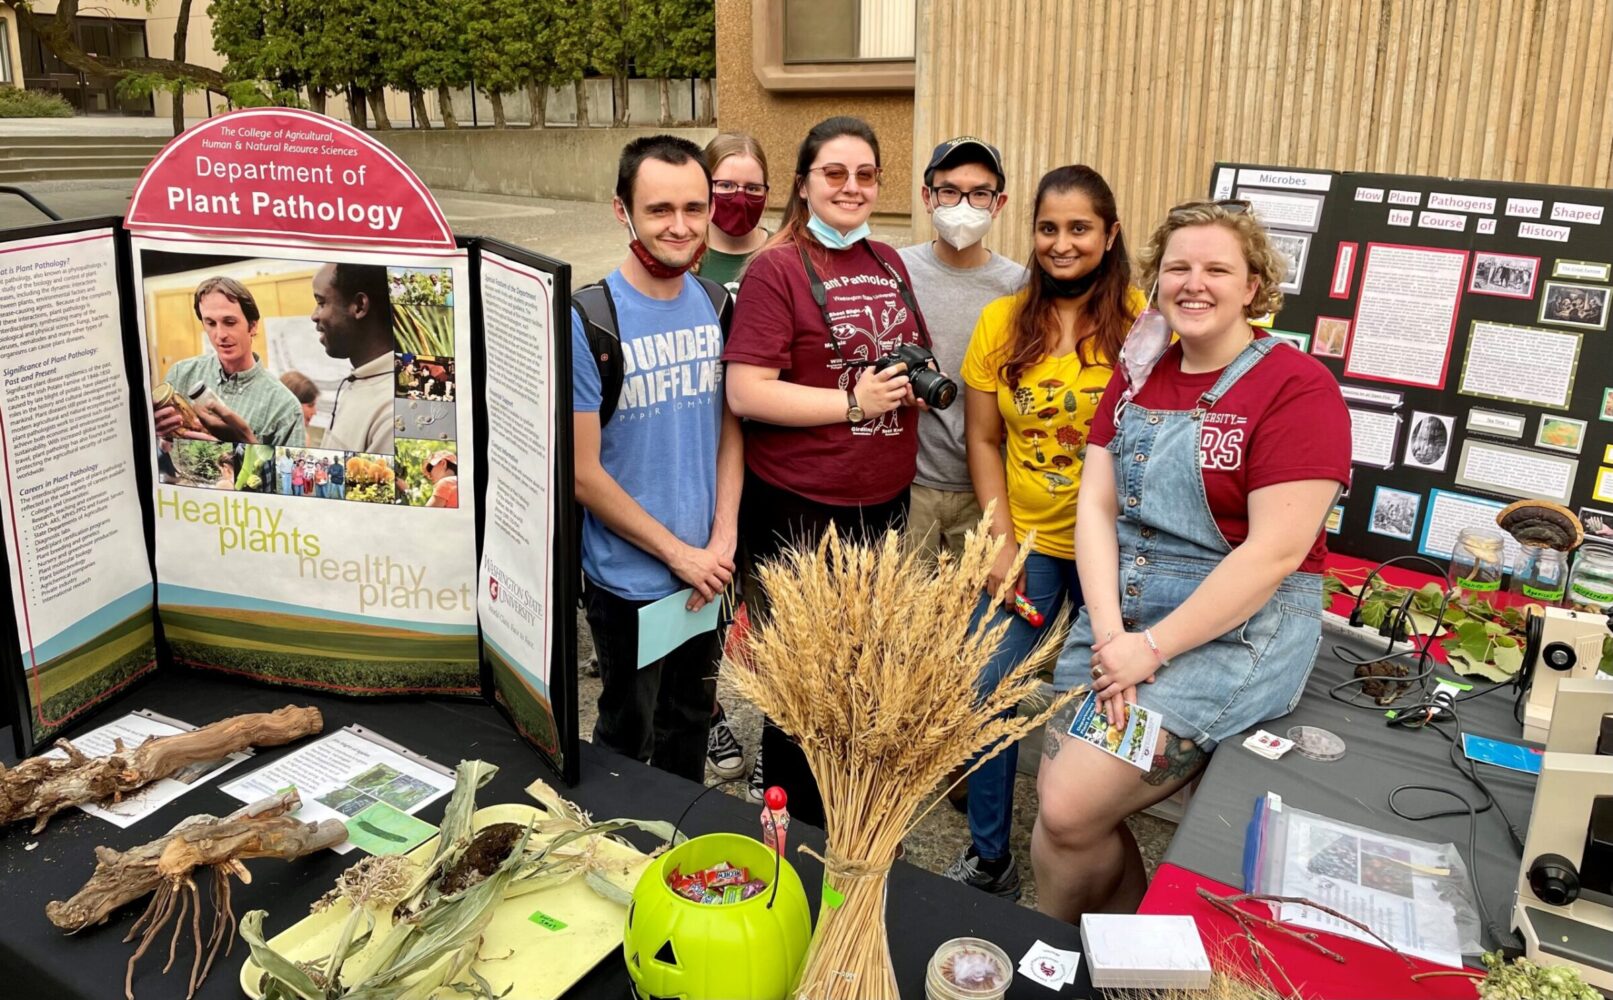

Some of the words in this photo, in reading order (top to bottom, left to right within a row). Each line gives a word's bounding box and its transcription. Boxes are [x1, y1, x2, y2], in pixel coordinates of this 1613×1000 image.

[202, 139, 232, 150] Human
[235, 140, 242, 150] &
[245, 141, 281, 152] Natural
[283, 143, 318, 154] Resource
[321, 145, 358, 157] Sciences
[220, 126, 236, 137] The
[238, 127, 271, 140] College
[274, 129, 284, 138] of
[285, 129, 335, 143] Agricultural,
[195, 156, 334, 185] Department
[342, 165, 367, 186] of
[1259, 174, 1307, 186] Microbes
[167, 187, 241, 215] Plant
[252, 191, 403, 231] Pathology
[1356, 189, 1382, 201] How
[1389, 192, 1418, 204] Plant
[1431, 195, 1493, 211] Pathogens
[1508, 203, 1540, 215] Have
[1553, 206, 1601, 222] Shaped
[1391, 212, 1410, 224] the
[1421, 215, 1463, 229] Course
[1479, 221, 1494, 231] of
[1520, 225, 1567, 240] History
[15, 264, 32, 272] Plant
[34, 258, 69, 269] Pathology?
[823, 278, 842, 290] ant
[840, 274, 898, 291] Patholog
[3, 362, 41, 377] Significance
[50, 354, 66, 364] Plant
[620, 324, 720, 376] DUNDER
[4, 377, 19, 386] Past
[20, 373, 33, 382] and
[35, 367, 56, 378] Present
[617, 360, 715, 410] MIFFLN
[1205, 413, 1237, 425] ERSITY
[1200, 426, 1244, 471] RS
[19, 484, 43, 496] Careers
[52, 473, 68, 484] Plant
[69, 463, 98, 477] Pathology
[156, 488, 283, 537] Healthy
[219, 521, 321, 558] plants
[299, 548, 427, 592] healthy
[359, 577, 471, 614] planet
